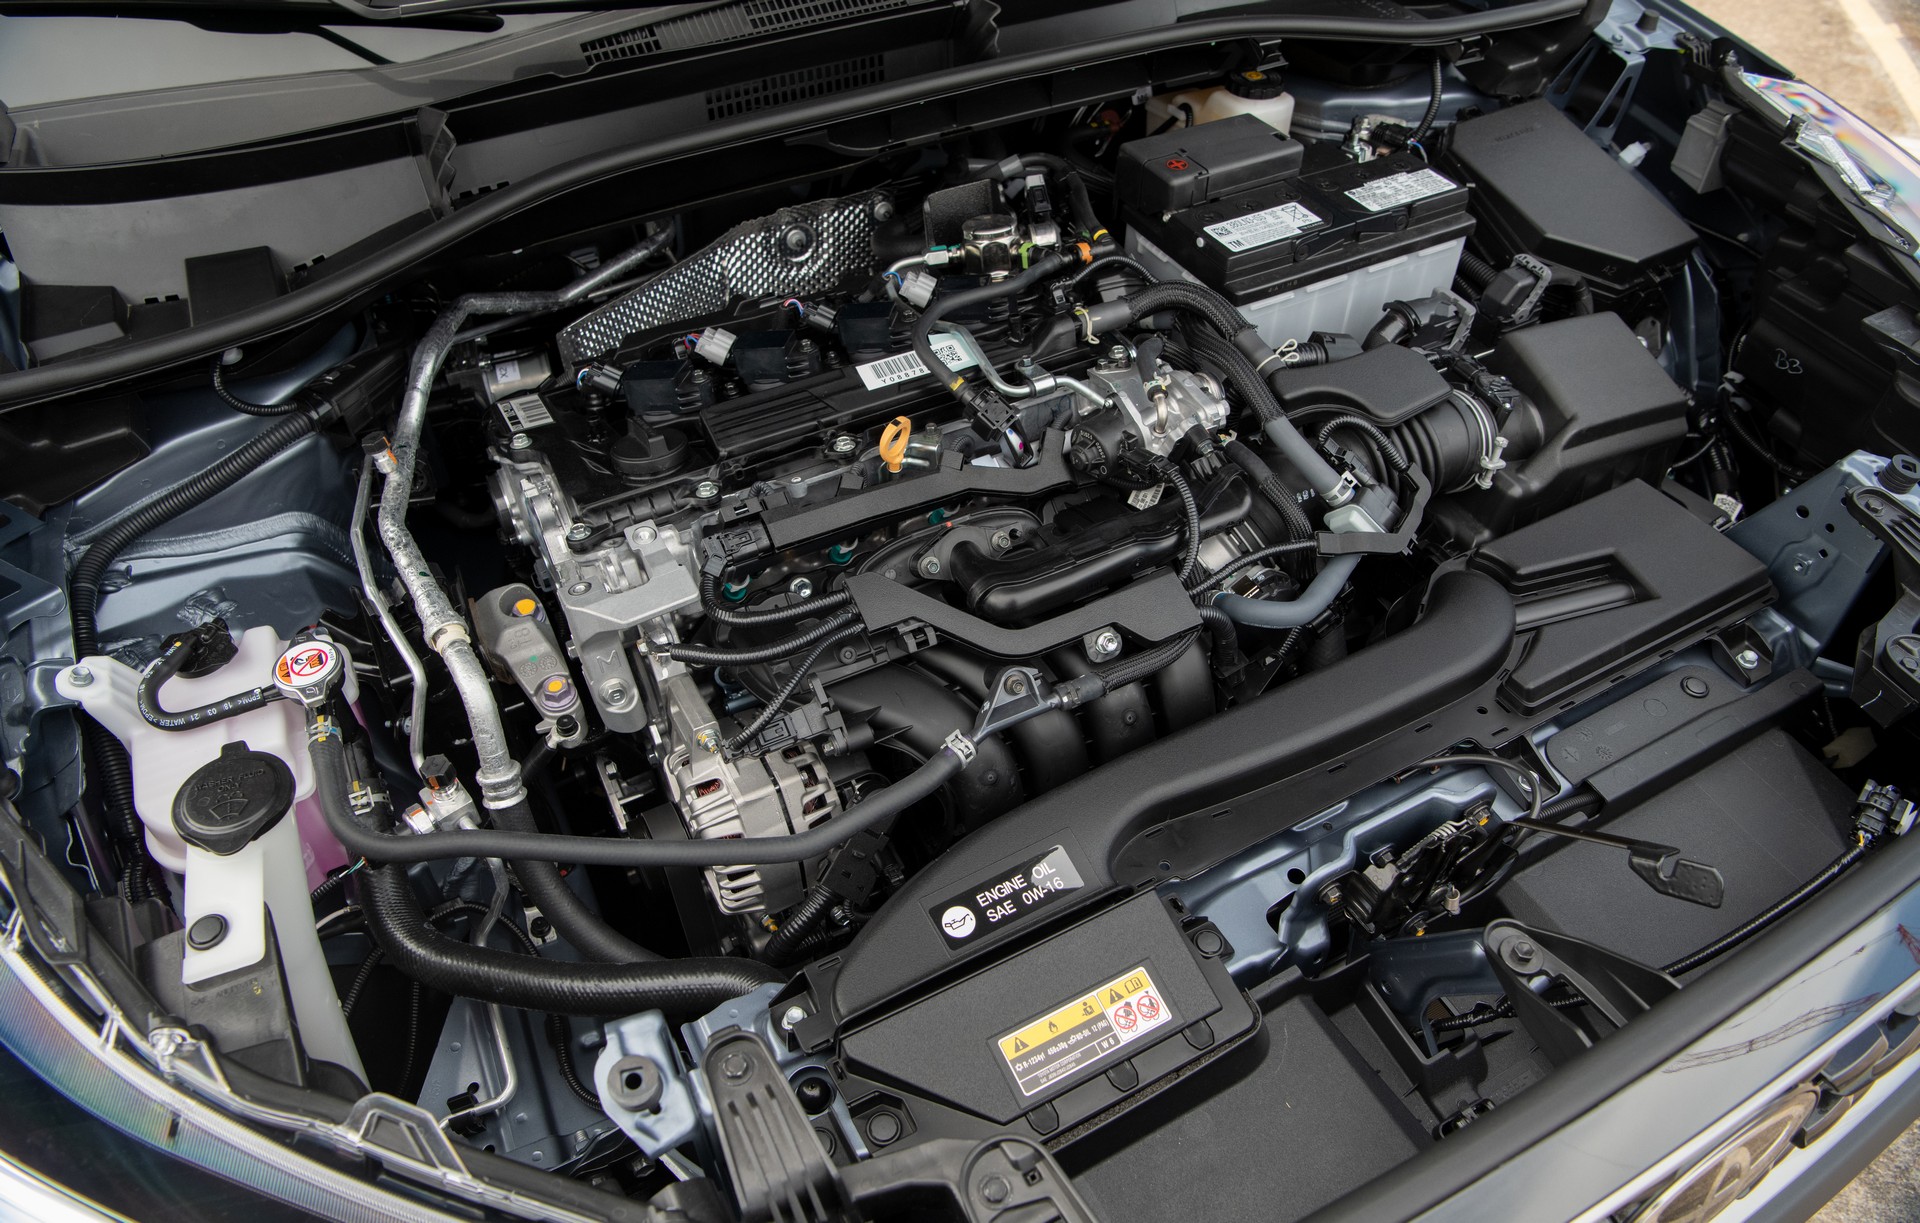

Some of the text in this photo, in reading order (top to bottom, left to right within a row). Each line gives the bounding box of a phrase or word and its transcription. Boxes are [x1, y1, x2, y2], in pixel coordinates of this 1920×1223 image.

[1227, 239, 1246, 250] TM
[1775, 347, 1804, 375] B3
[159, 717, 186, 727] WATER
[238, 767, 265, 781] FLUID
[217, 782, 241, 793] ONLY
[975, 862, 1057, 908] ENGINE OIL
[986, 876, 1065, 923] SAE 0W-16
[1100, 1040, 1110, 1050] W
